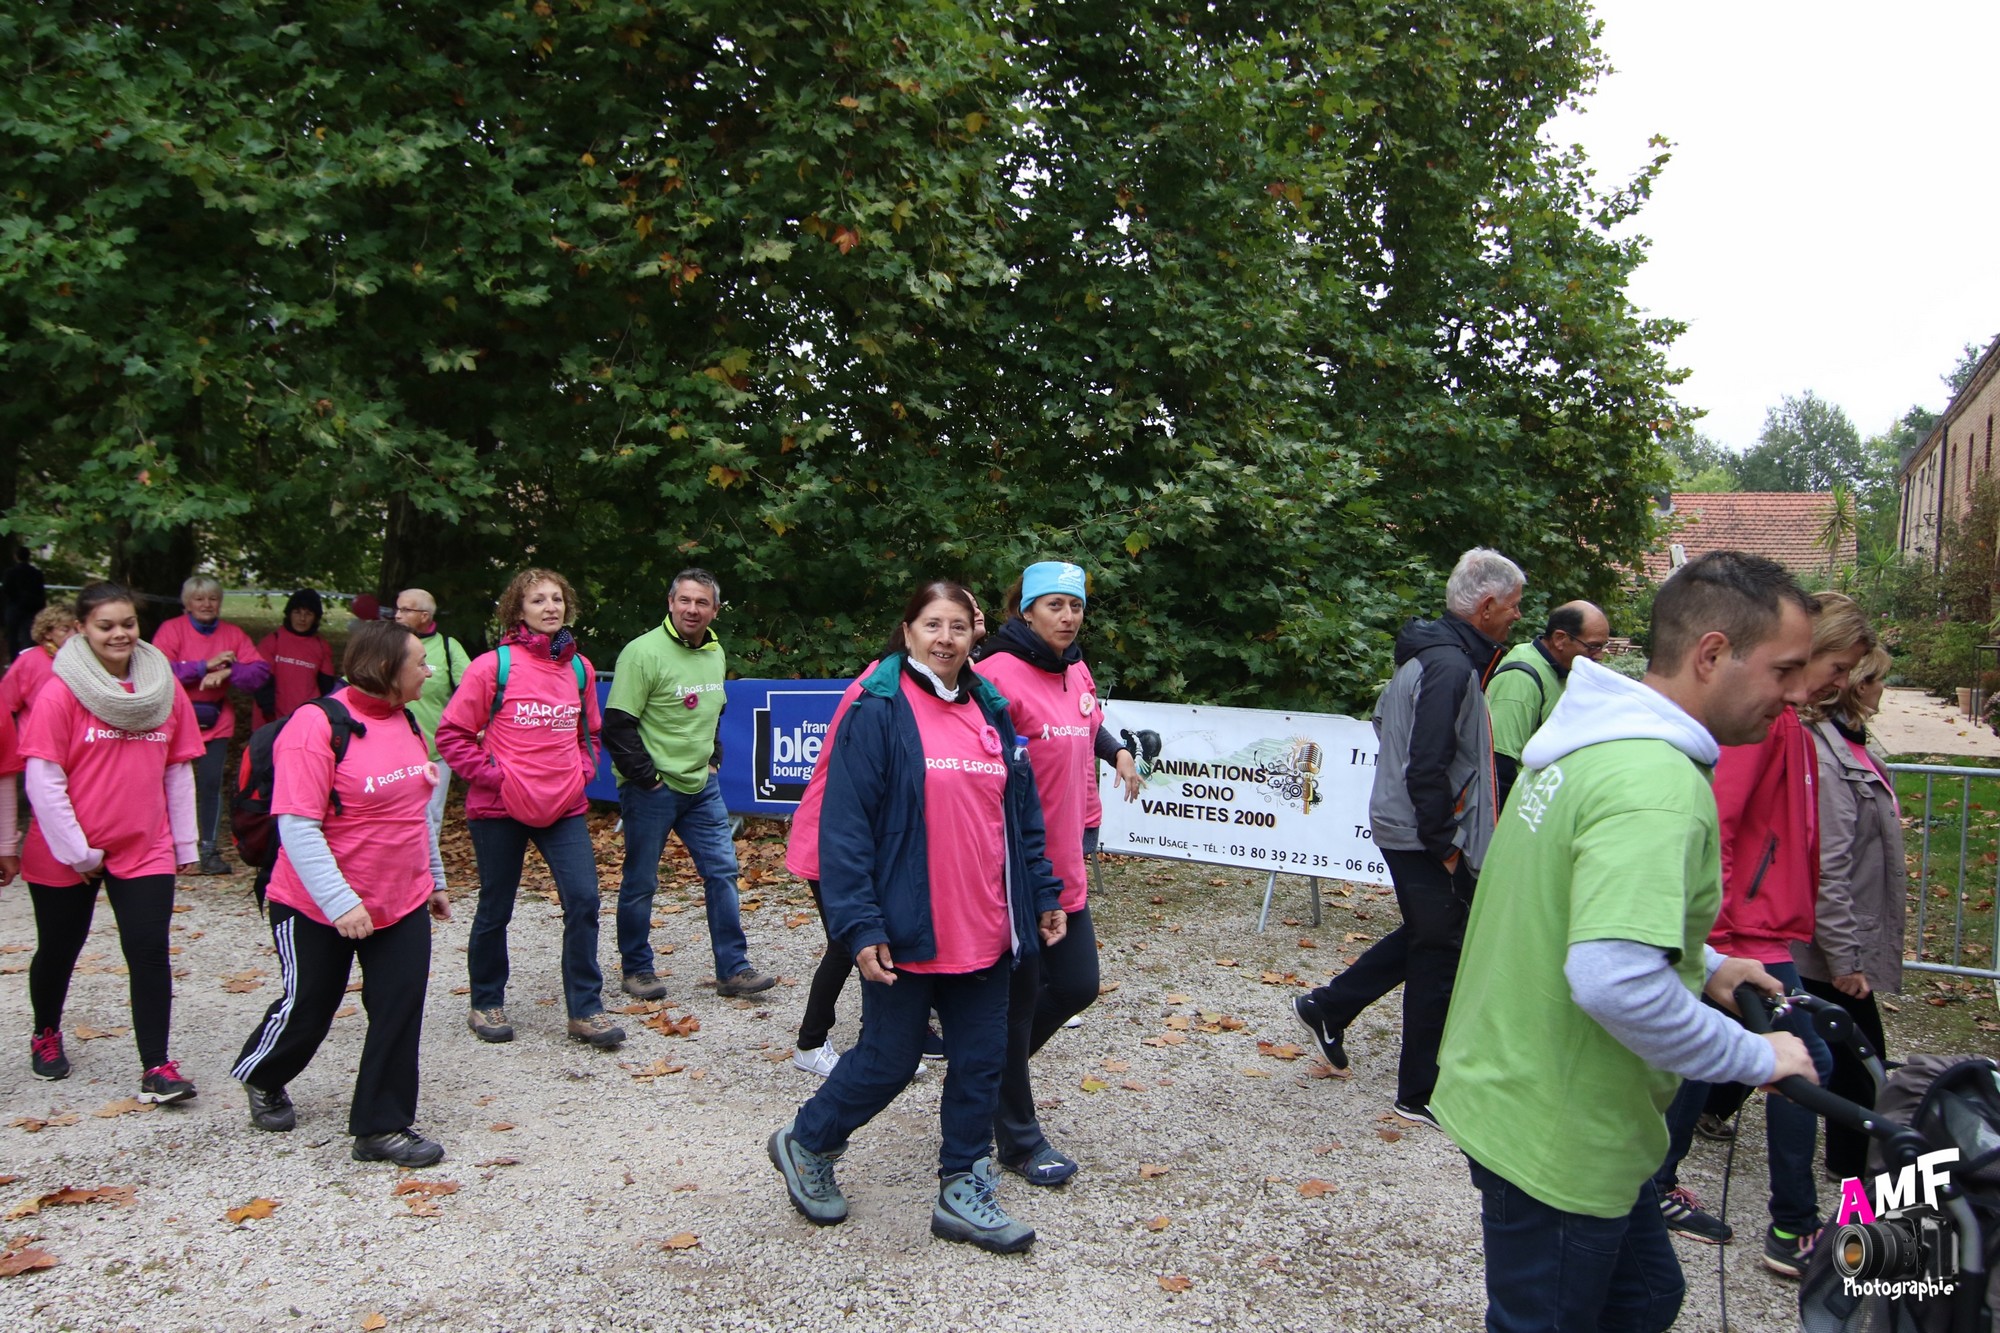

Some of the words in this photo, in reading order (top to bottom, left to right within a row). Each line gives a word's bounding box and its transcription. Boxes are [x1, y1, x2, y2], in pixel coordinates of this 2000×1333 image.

[684, 684, 705, 695] ROSE
[513, 716, 540, 727] POUR
[543, 718, 551, 727] Y
[773, 727, 823, 763] ble
[377, 768, 406, 787] ROSE
[407, 764, 426, 777] ESP
[925, 757, 961, 770] ROSE
[962, 759, 1006, 776] ESPOIR
[1152, 759, 1267, 784] ANIMATIONS
[1182, 783, 1234, 802] SONO
[1141, 799, 1229, 823] VARIETES
[1234, 809, 1276, 828] 2000
[1230, 845, 1245, 856] 03
[1250, 847, 1266, 859] 80
[1271, 850, 1287, 862] 39
[1291, 852, 1307, 864] 22
[1312, 854, 1328, 867] 35
[1345, 859, 1362, 871] 06
[1367, 861, 1384, 873] 66
